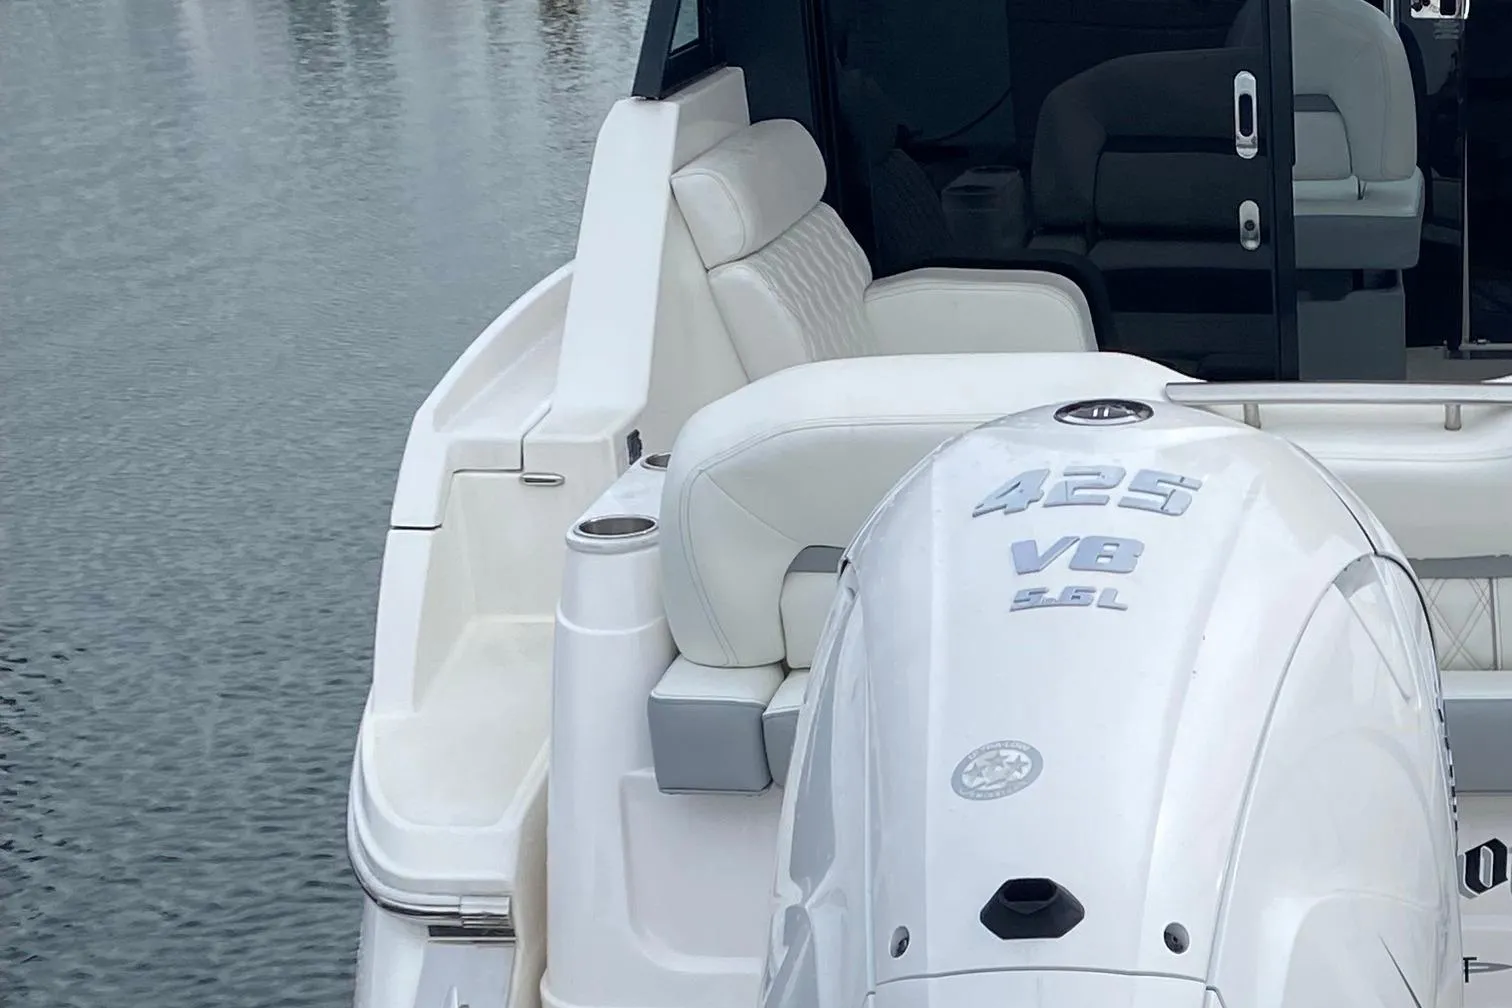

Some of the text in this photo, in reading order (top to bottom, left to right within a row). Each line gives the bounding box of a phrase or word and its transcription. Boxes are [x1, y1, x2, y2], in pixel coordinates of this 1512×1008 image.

[972, 465, 1203, 518] 425
[1010, 535, 1145, 575] V8
[1009, 585, 1129, 613] 5.6L
